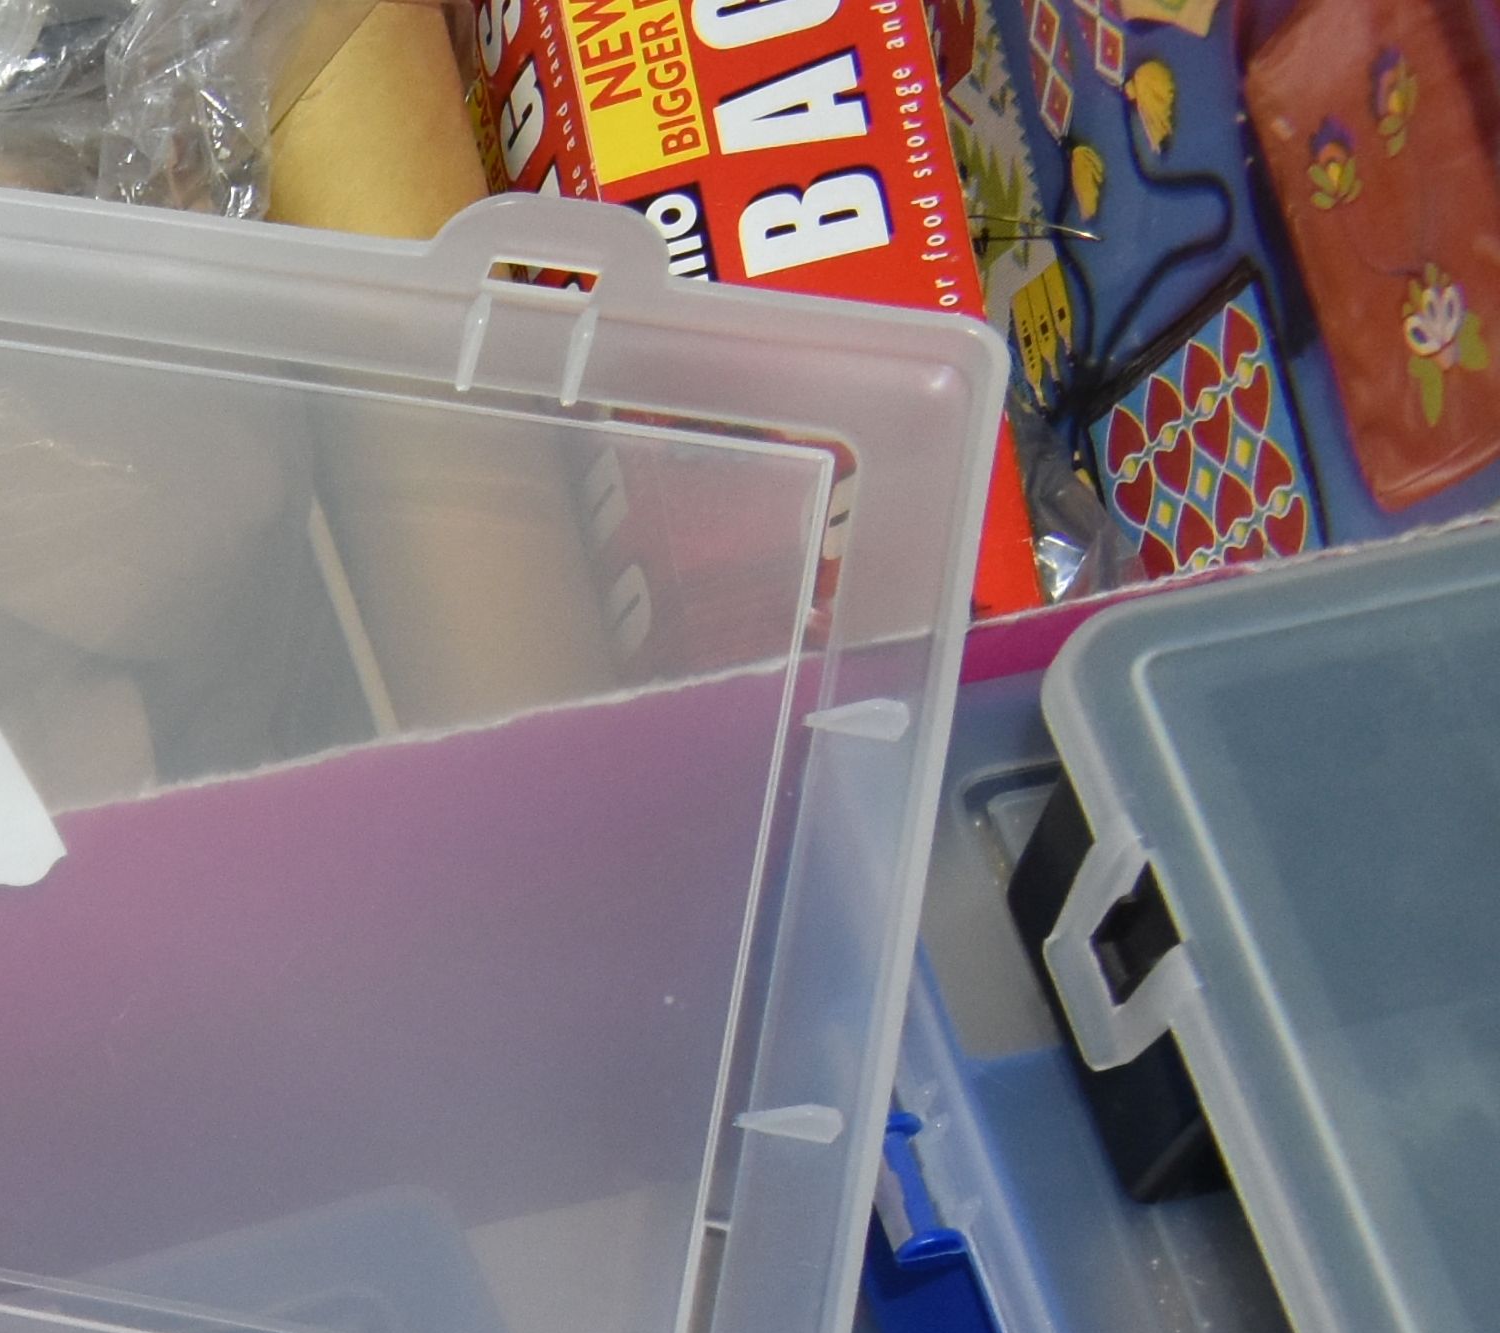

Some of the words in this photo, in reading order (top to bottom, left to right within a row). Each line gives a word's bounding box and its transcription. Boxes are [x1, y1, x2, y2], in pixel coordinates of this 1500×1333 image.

[871, 0, 908, 51] and
[639, 12, 702, 157] BIGGER
[892, 66, 934, 180] storage
[911, 193, 950, 262] food
[934, 275, 961, 308] or
